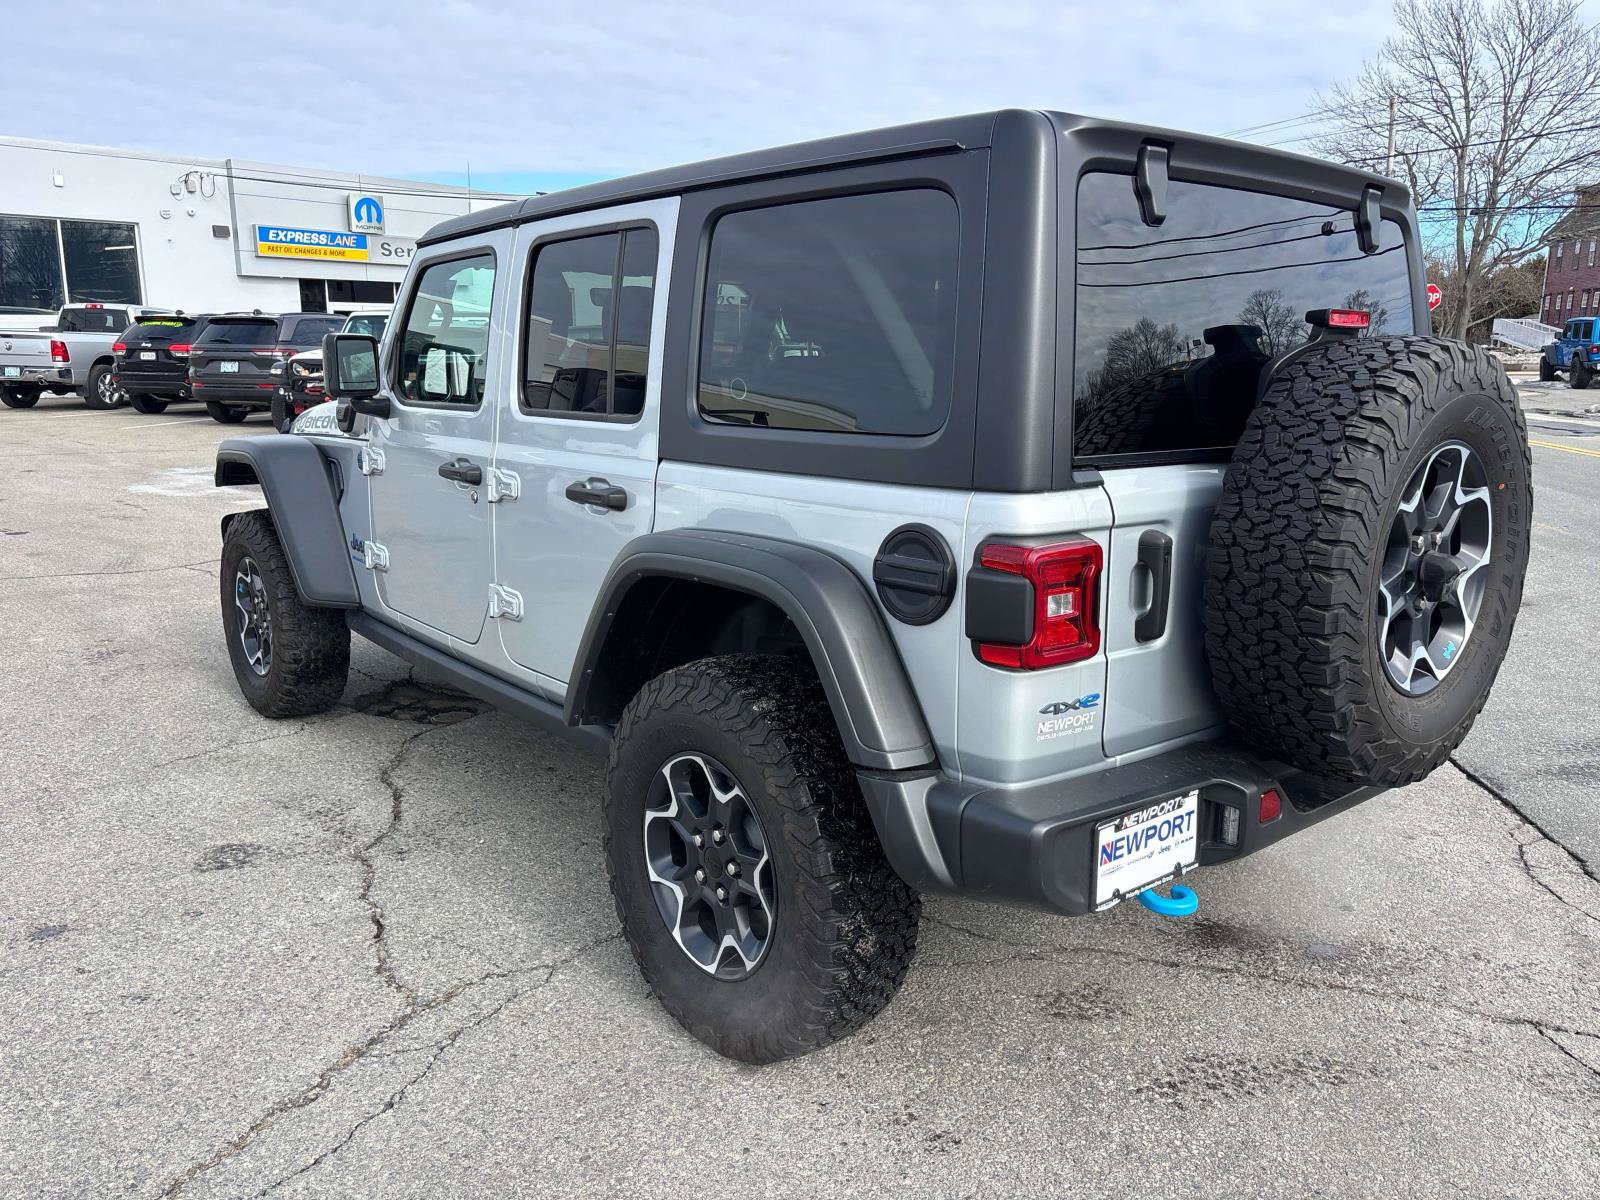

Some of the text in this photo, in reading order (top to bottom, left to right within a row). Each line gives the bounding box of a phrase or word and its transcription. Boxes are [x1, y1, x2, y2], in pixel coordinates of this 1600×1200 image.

[267, 245, 282, 253] FAST
[283, 246, 293, 254] OIL
[294, 247, 322, 256] CHANGES
[323, 248, 328, 256] &
[1037, 711, 1097, 735] NEWPORT
[1121, 796, 1183, 830] NEWPORT
[1099, 809, 1196, 867] NEWPORT
